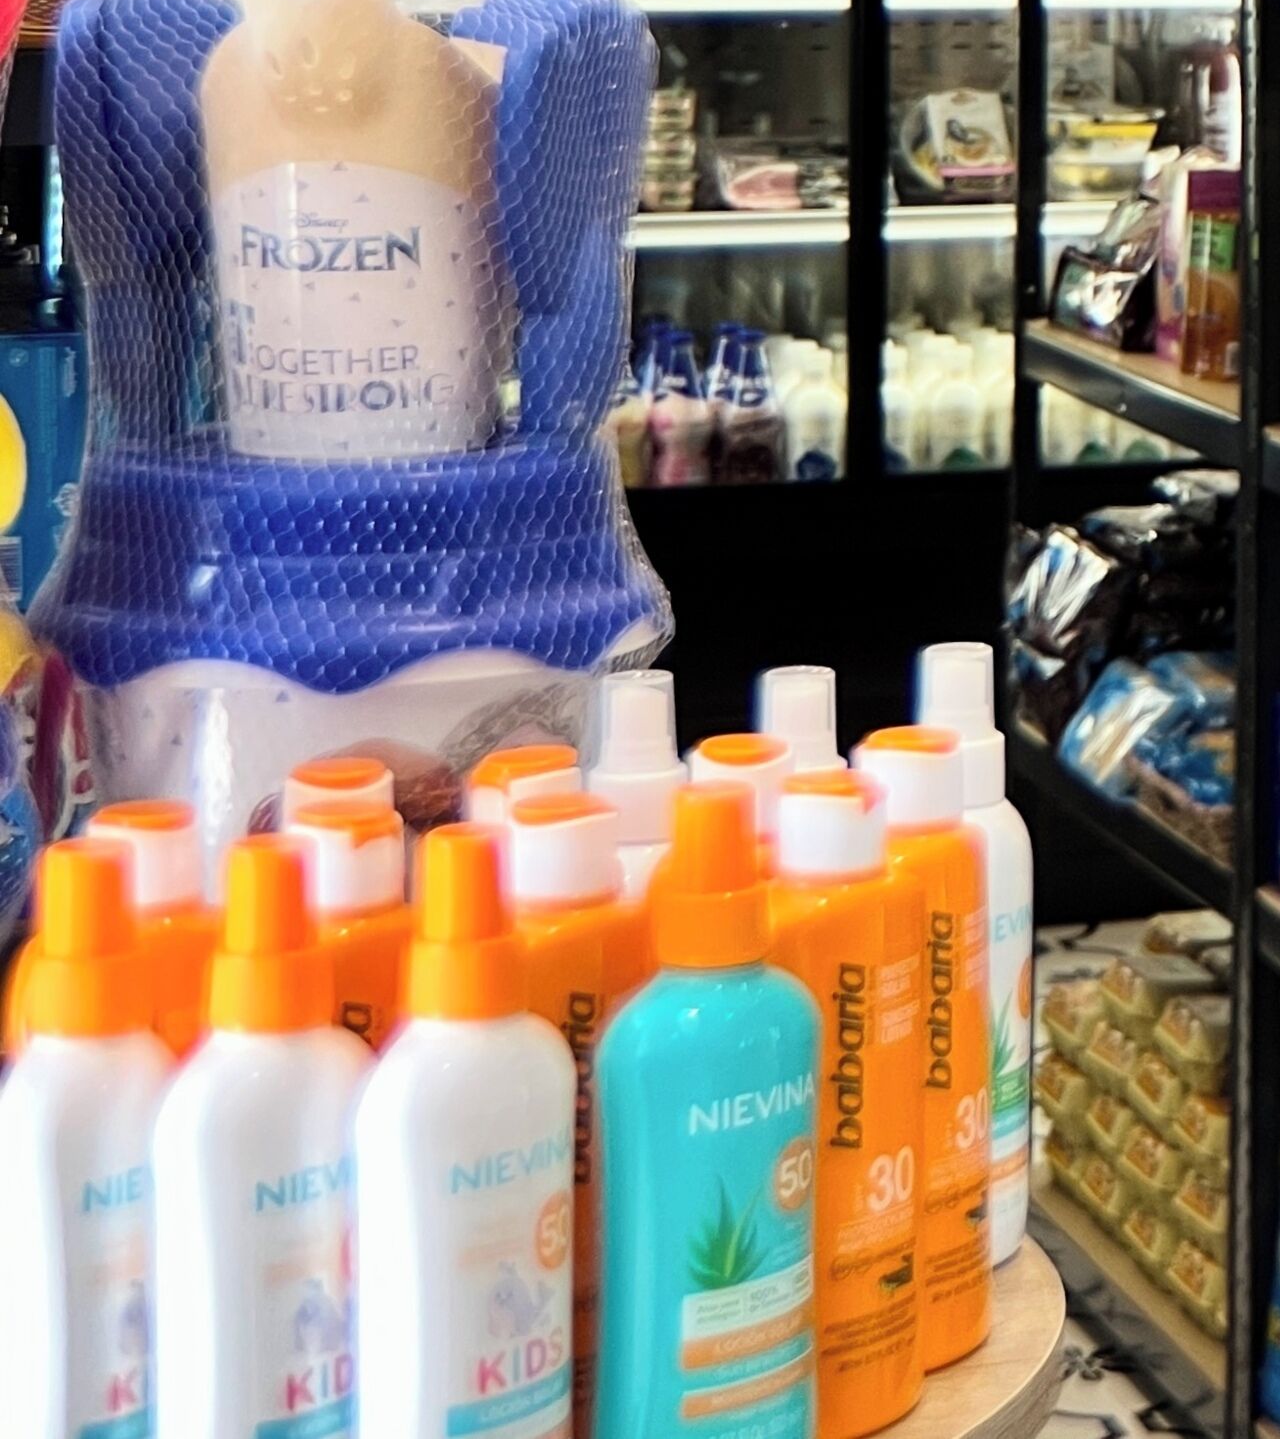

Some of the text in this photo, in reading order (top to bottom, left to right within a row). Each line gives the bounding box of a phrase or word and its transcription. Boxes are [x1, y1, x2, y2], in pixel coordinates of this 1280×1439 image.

[240, 224, 422, 273] FROZEN
[925, 910, 954, 1090] babaria
[830, 962, 867, 1149] babaria
[956, 1086, 989, 1150] 30
[778, 1148, 813, 1199] 50
[867, 1145, 915, 1212] 30
[476, 1327, 563, 1395] KIDS
